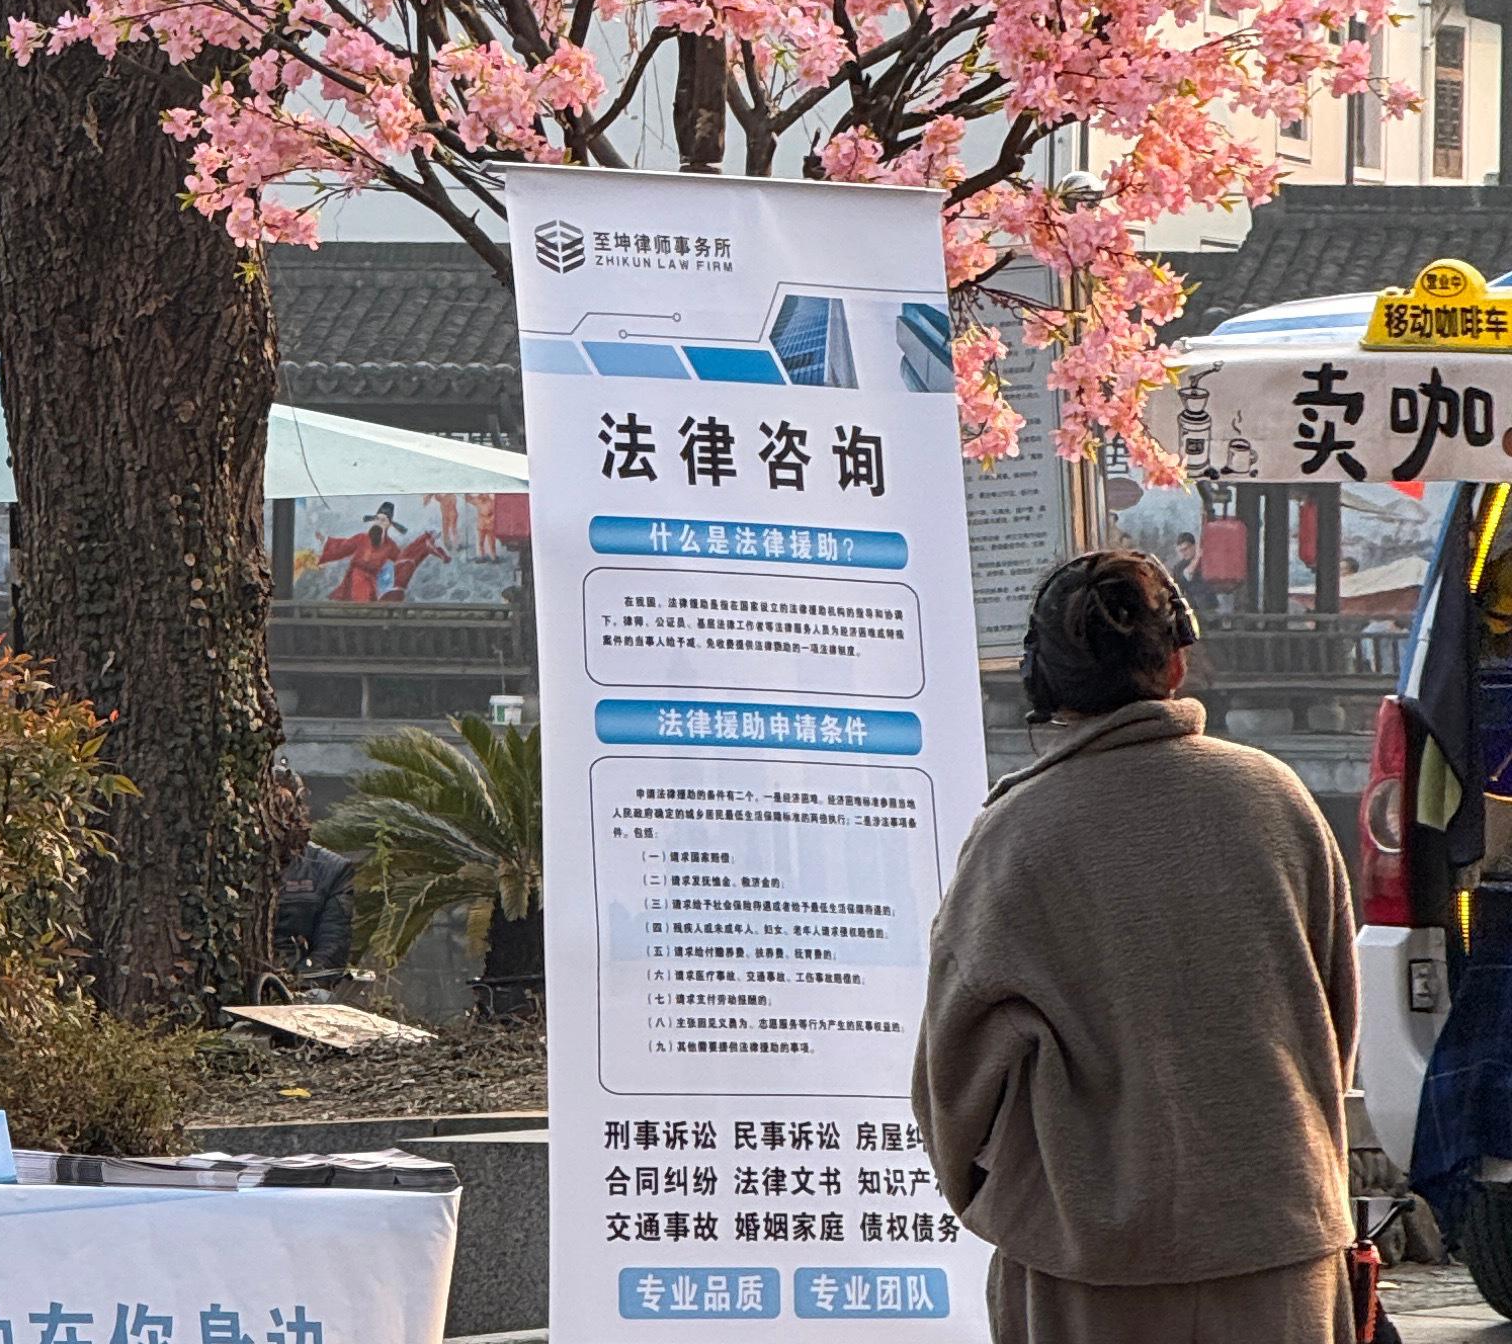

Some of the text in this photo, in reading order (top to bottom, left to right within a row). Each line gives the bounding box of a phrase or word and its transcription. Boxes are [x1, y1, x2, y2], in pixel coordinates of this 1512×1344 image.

[593, 230, 733, 260] 至坤律师事务所
[594, 254, 734, 273] ZHIKUN LAW FIRM
[1384, 303, 1508, 340] 移动咖啡车
[596, 412, 888, 498] 法律咨询
[649, 521, 855, 563] 什么是法律援助？
[657, 708, 869, 746] 法律援助申请条件
[603, 1119, 928, 1153] 刑事诉讼 民事诉讼 房屋纠
[604, 1165, 943, 1197] 合同纠纷 法律文书 知识产
[605, 1211, 961, 1243] 交通事故 婚姻家庭 债权债务
[636, 1273, 935, 1313] 专业品质 专业团队
